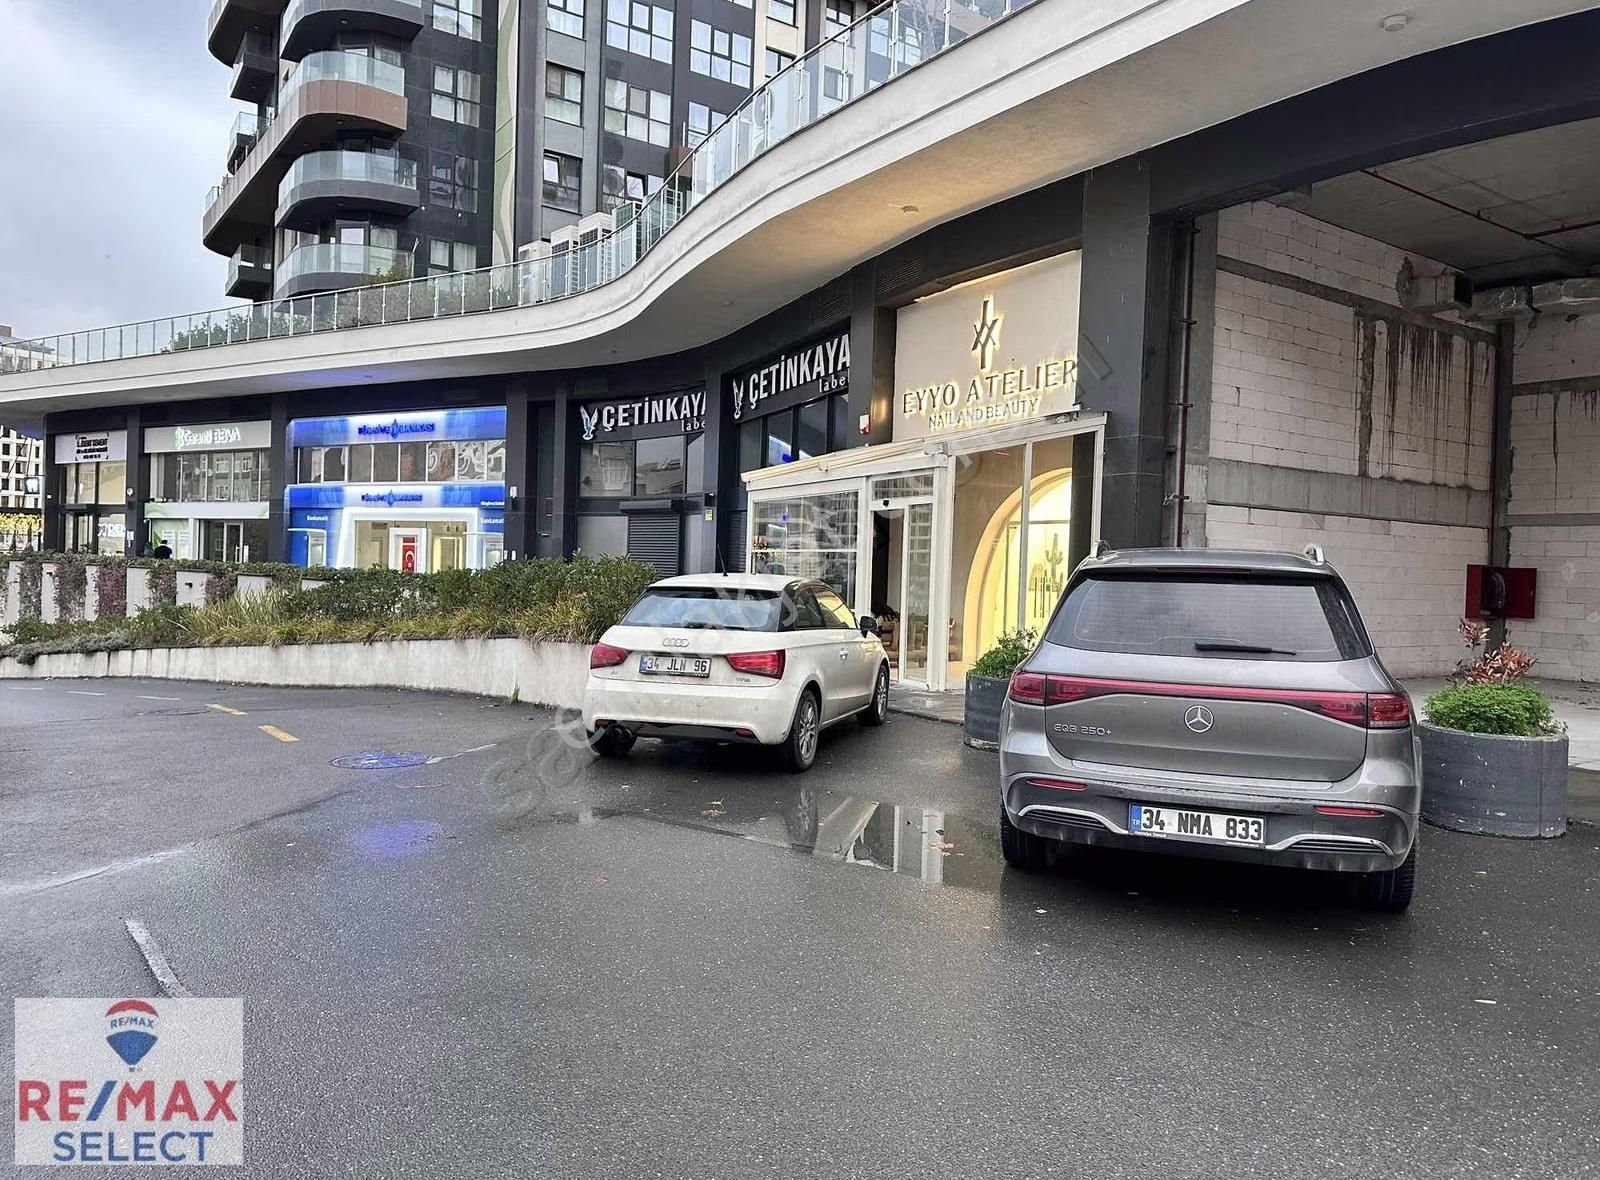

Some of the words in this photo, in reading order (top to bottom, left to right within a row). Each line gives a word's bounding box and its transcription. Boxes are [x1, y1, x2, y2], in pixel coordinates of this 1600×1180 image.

[749, 333, 850, 409] ÇETİNKAYA
[903, 382, 956, 415] EYYO
[966, 359, 1078, 403] ATELIER
[928, 412, 953, 429] NAIL
[956, 408, 983, 425] AND
[986, 398, 1039, 420] BEAUTY
[647, 657, 660, 670] 34
[693, 660, 707, 672] 96
[1053, 723, 1077, 733] EQB
[1080, 725, 1112, 736] 250+
[1142, 809, 1166, 831] 34
[1177, 812, 1213, 836] NMA
[1225, 818, 1262, 840] 833
